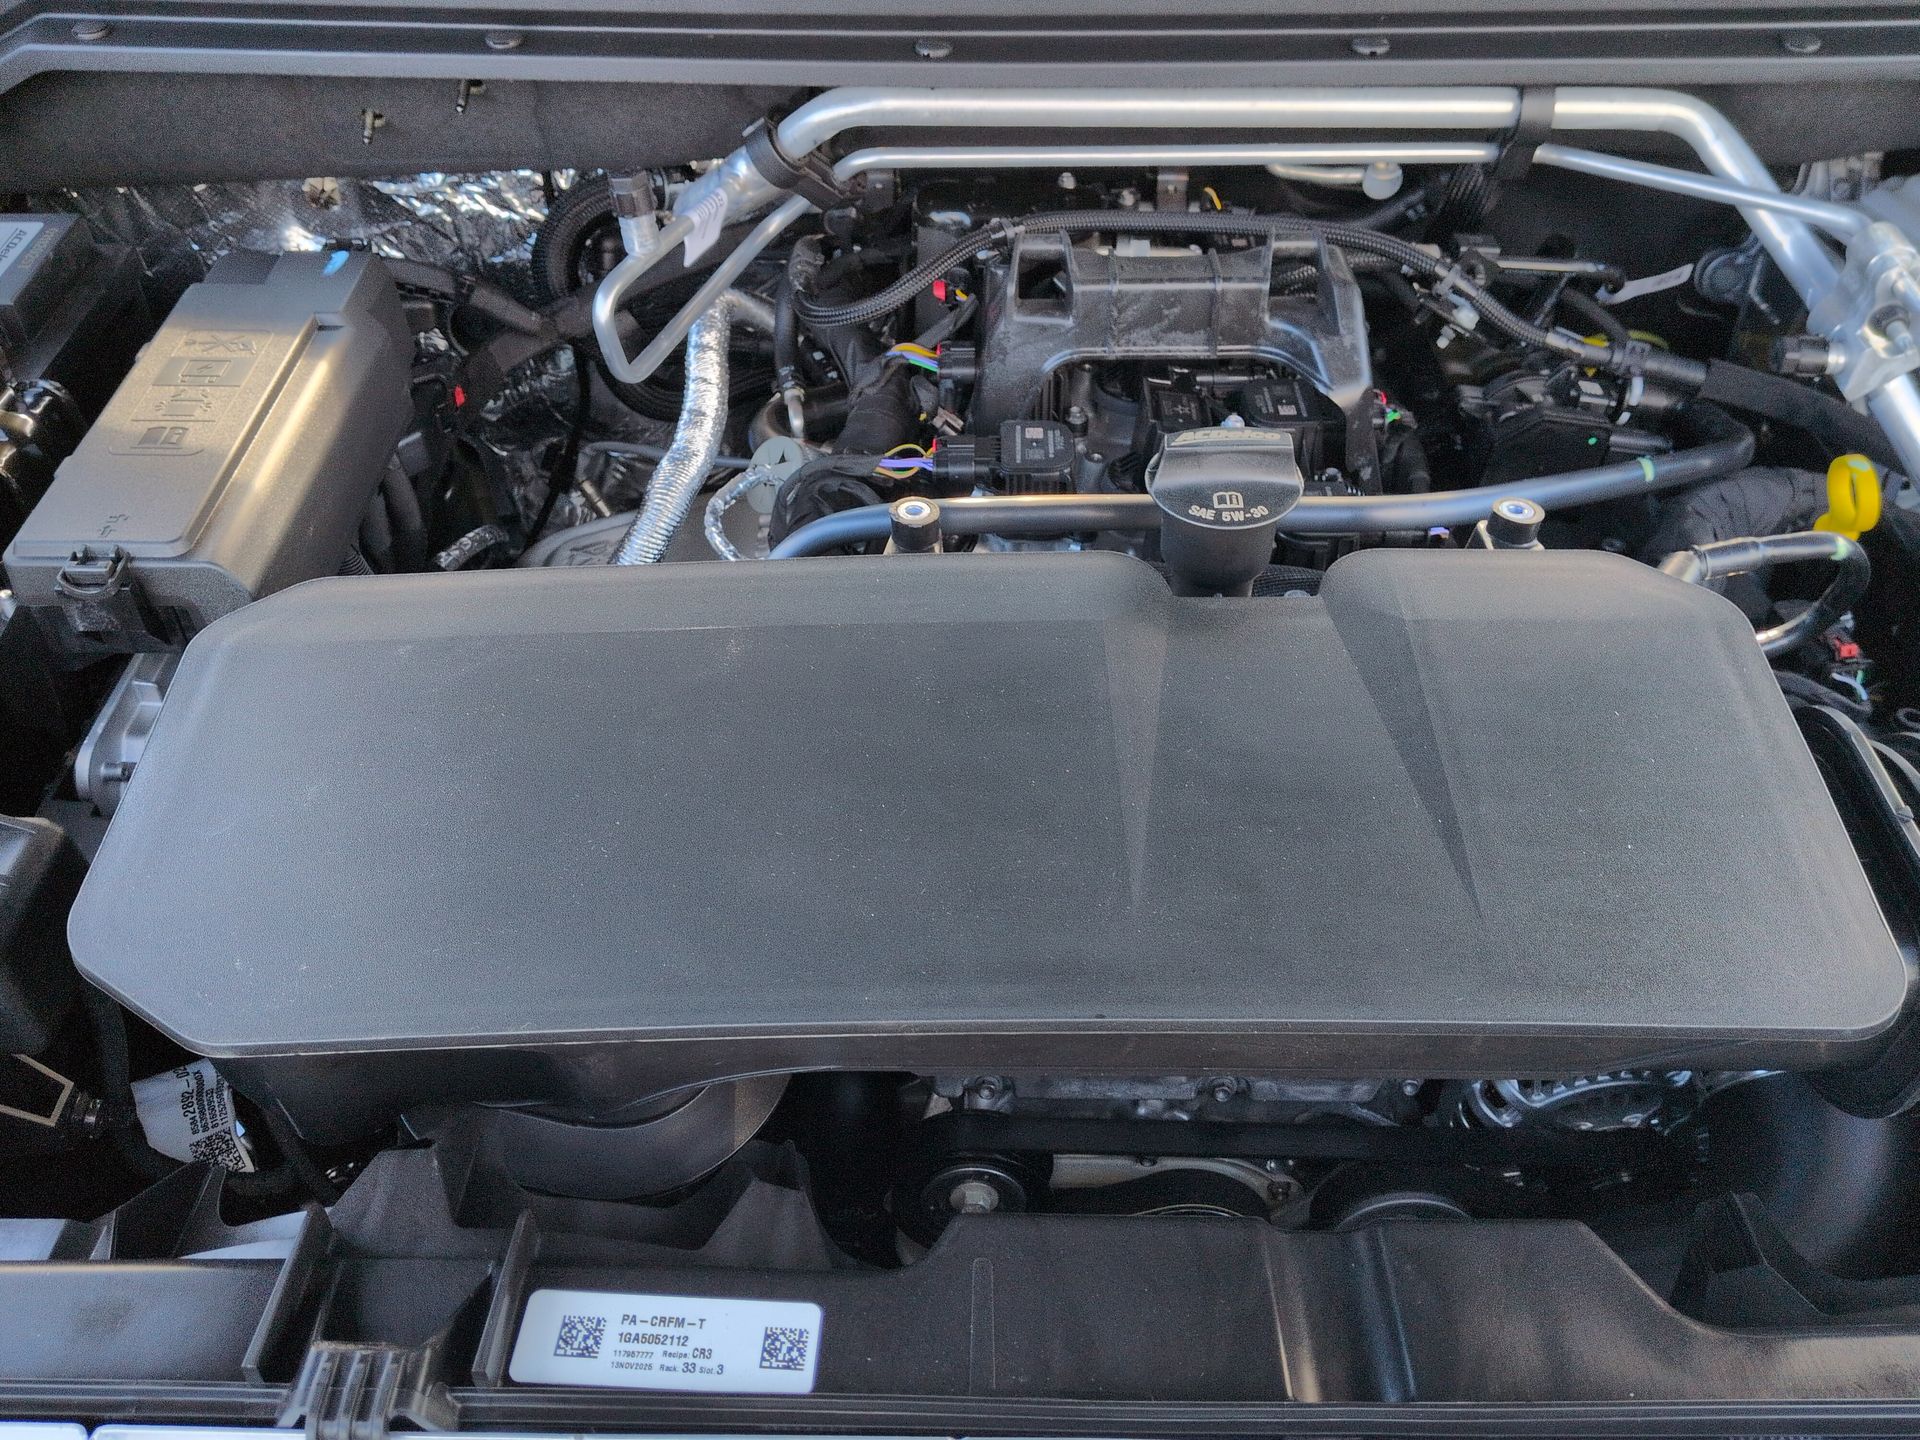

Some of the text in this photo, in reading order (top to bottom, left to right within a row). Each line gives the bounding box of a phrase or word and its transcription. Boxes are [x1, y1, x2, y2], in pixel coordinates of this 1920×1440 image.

[0, 229, 27, 262] ACDel
[1188, 505, 1269, 522] SAE 5W-30
[617, 1332, 689, 1347] 1GA5052112
[662, 1350, 690, 1360] Recipe:
[692, 1348, 713, 1360] CR3
[610, 1361, 653, 1371] 13NOV2025
[681, 1362, 697, 1374] 33
[716, 1364, 724, 1375] 3
